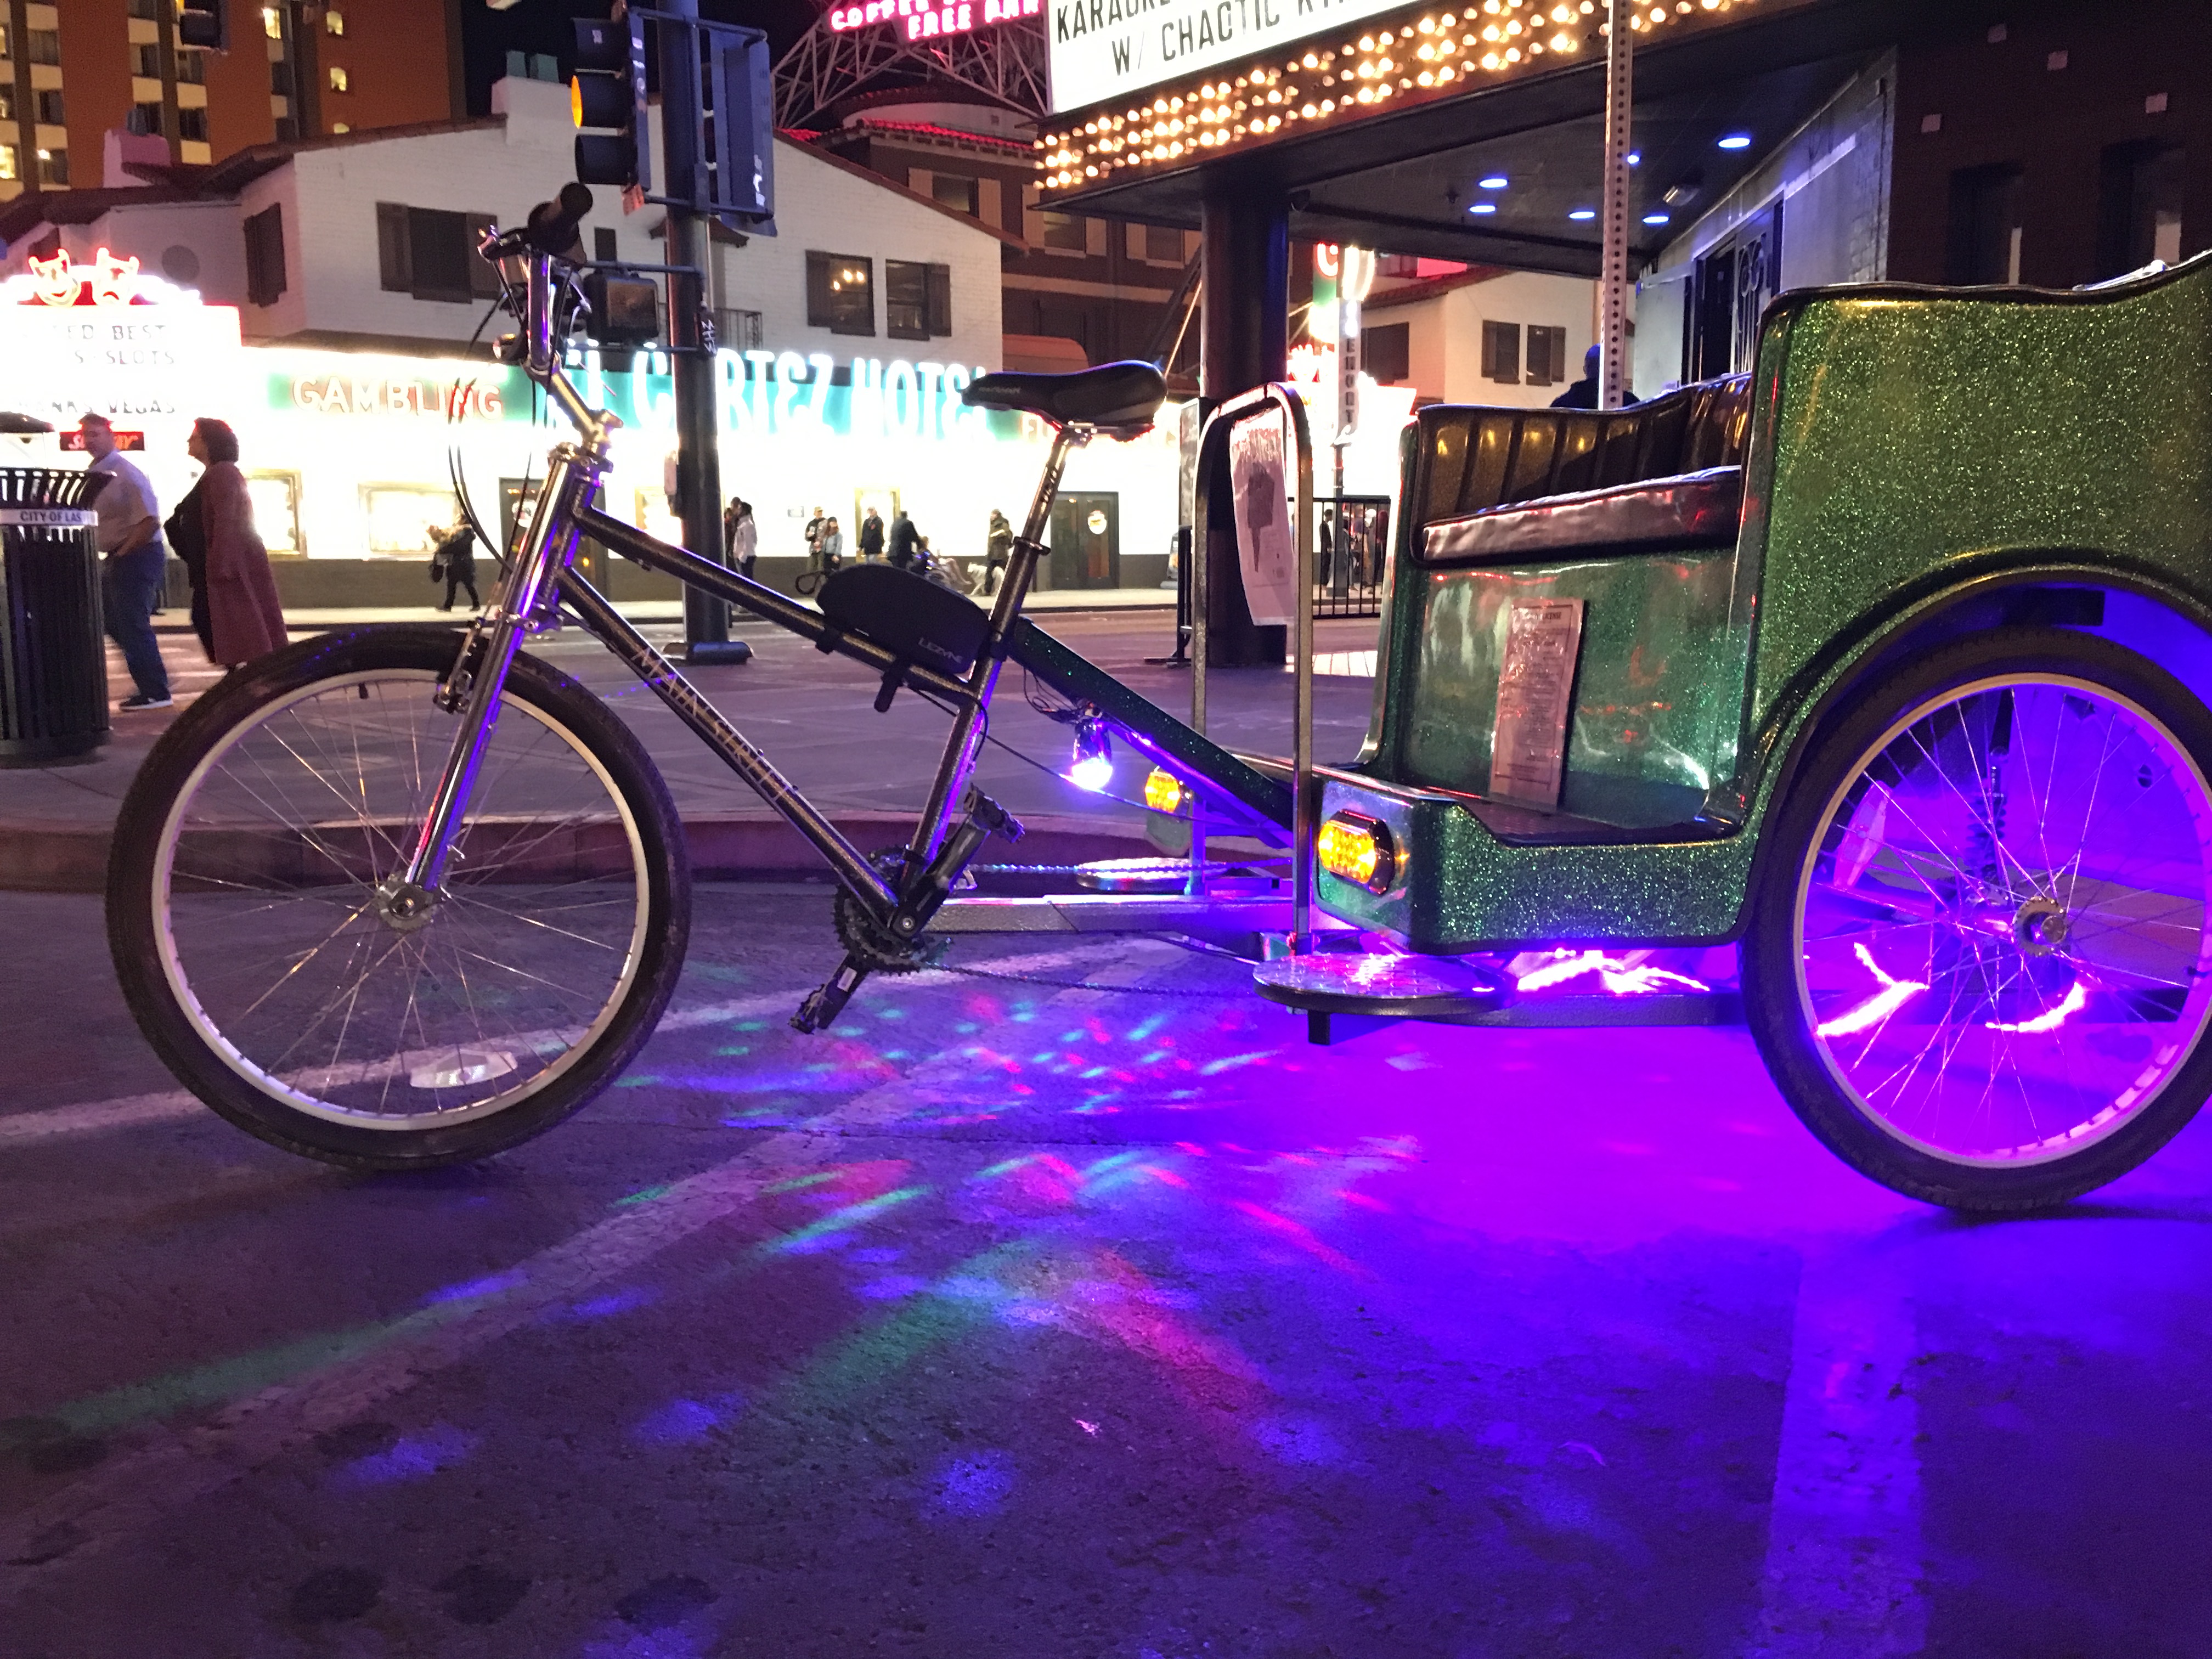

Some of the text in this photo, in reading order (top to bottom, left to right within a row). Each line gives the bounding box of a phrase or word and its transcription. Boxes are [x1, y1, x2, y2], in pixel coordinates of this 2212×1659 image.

[907, 4, 971, 40] FREE
[106, 349, 174, 364] SLOTS
[108, 399, 175, 414] VEGAS
[292, 375, 503, 420] GAMBLING
[633, 341, 835, 437] CRTEZ
[20, 511, 82, 522] CITY OF LAS
[630, 644, 794, 806] MAIN STREET
